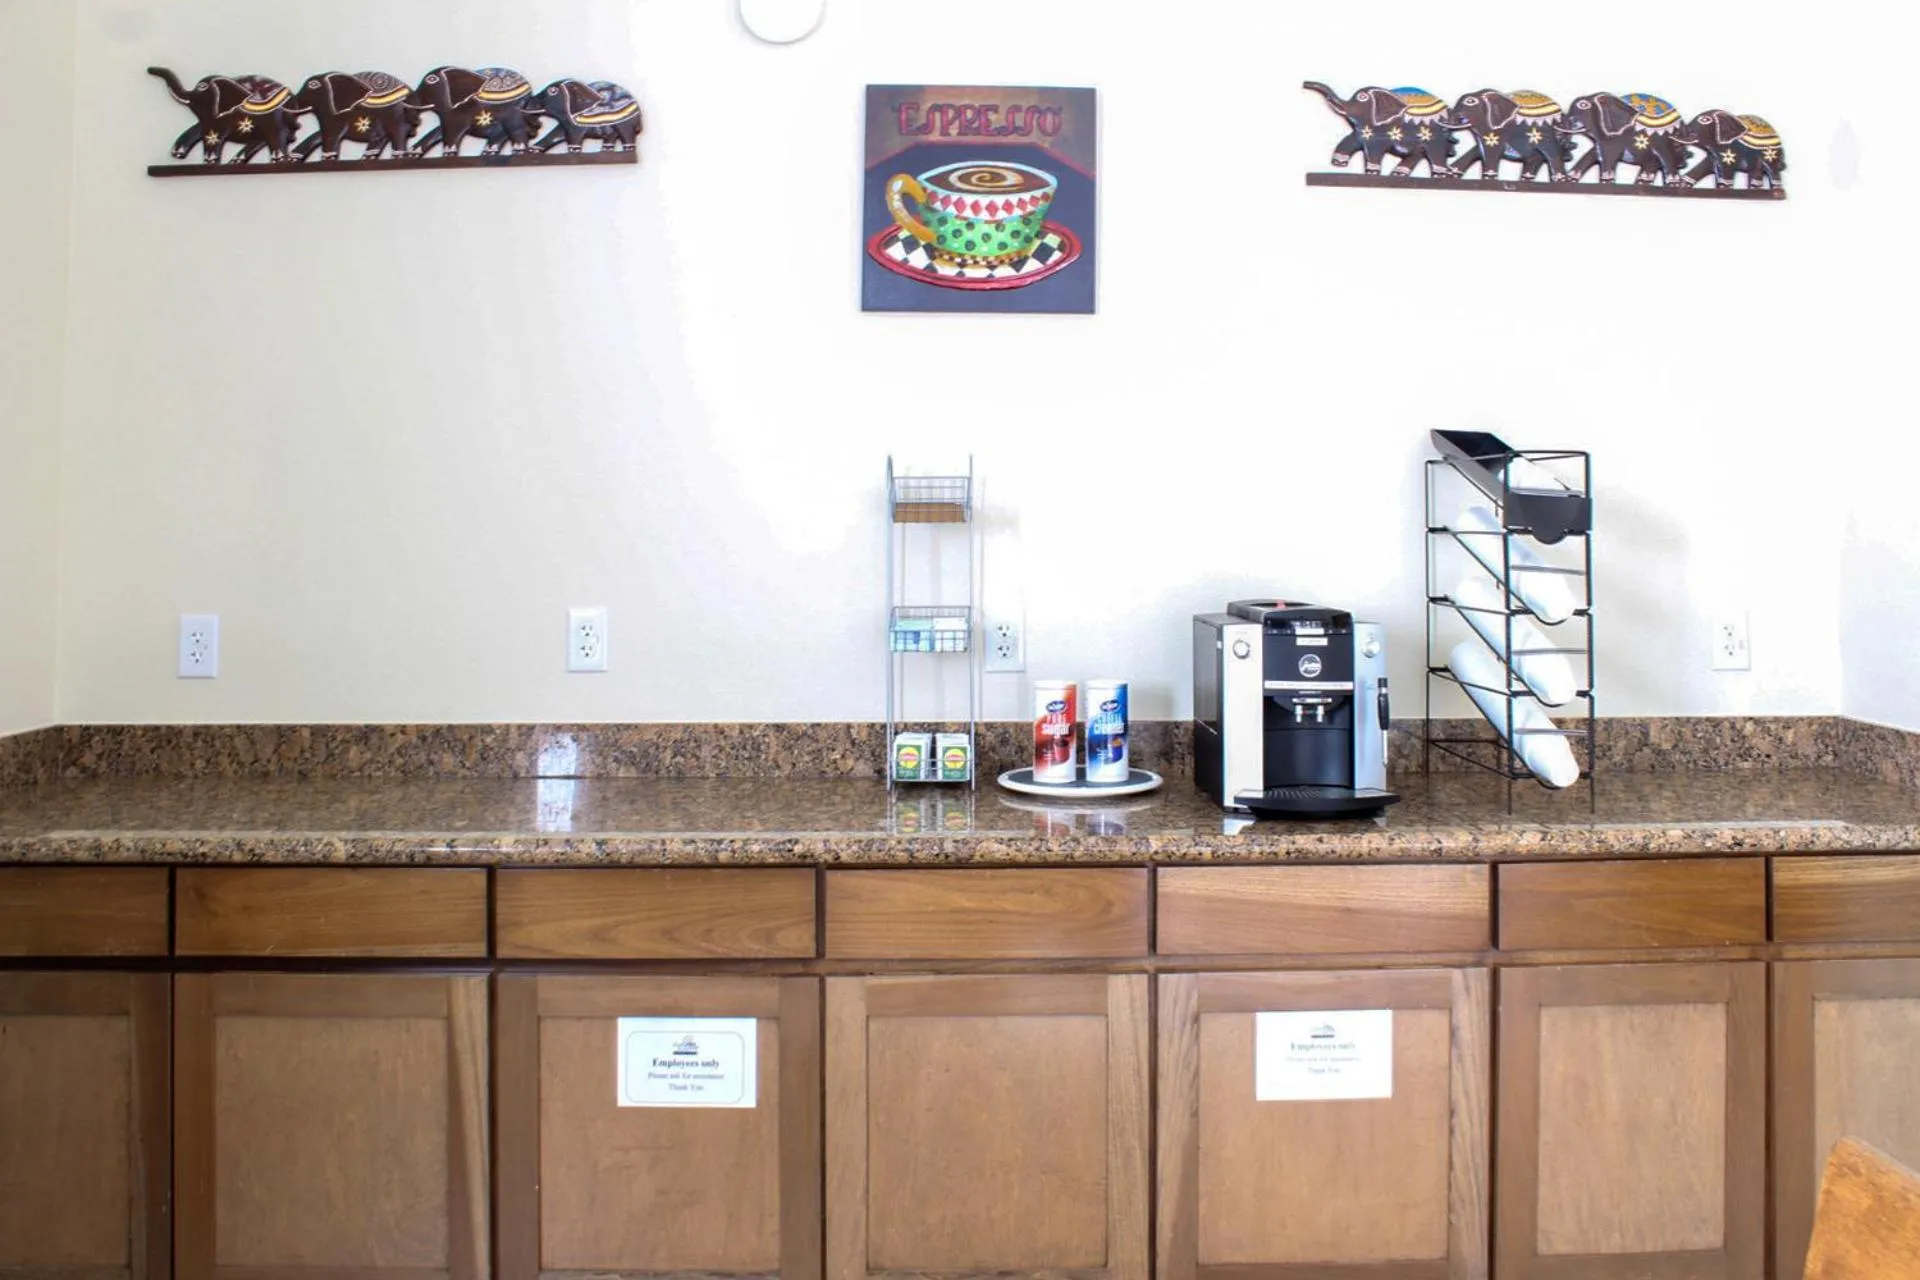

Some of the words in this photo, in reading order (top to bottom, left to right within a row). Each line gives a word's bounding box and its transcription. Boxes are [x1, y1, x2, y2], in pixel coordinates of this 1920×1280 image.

[896, 101, 1063, 137] ESPRESSO
[652, 1057, 699, 1069] Employees
[701, 1057, 720, 1069] only
